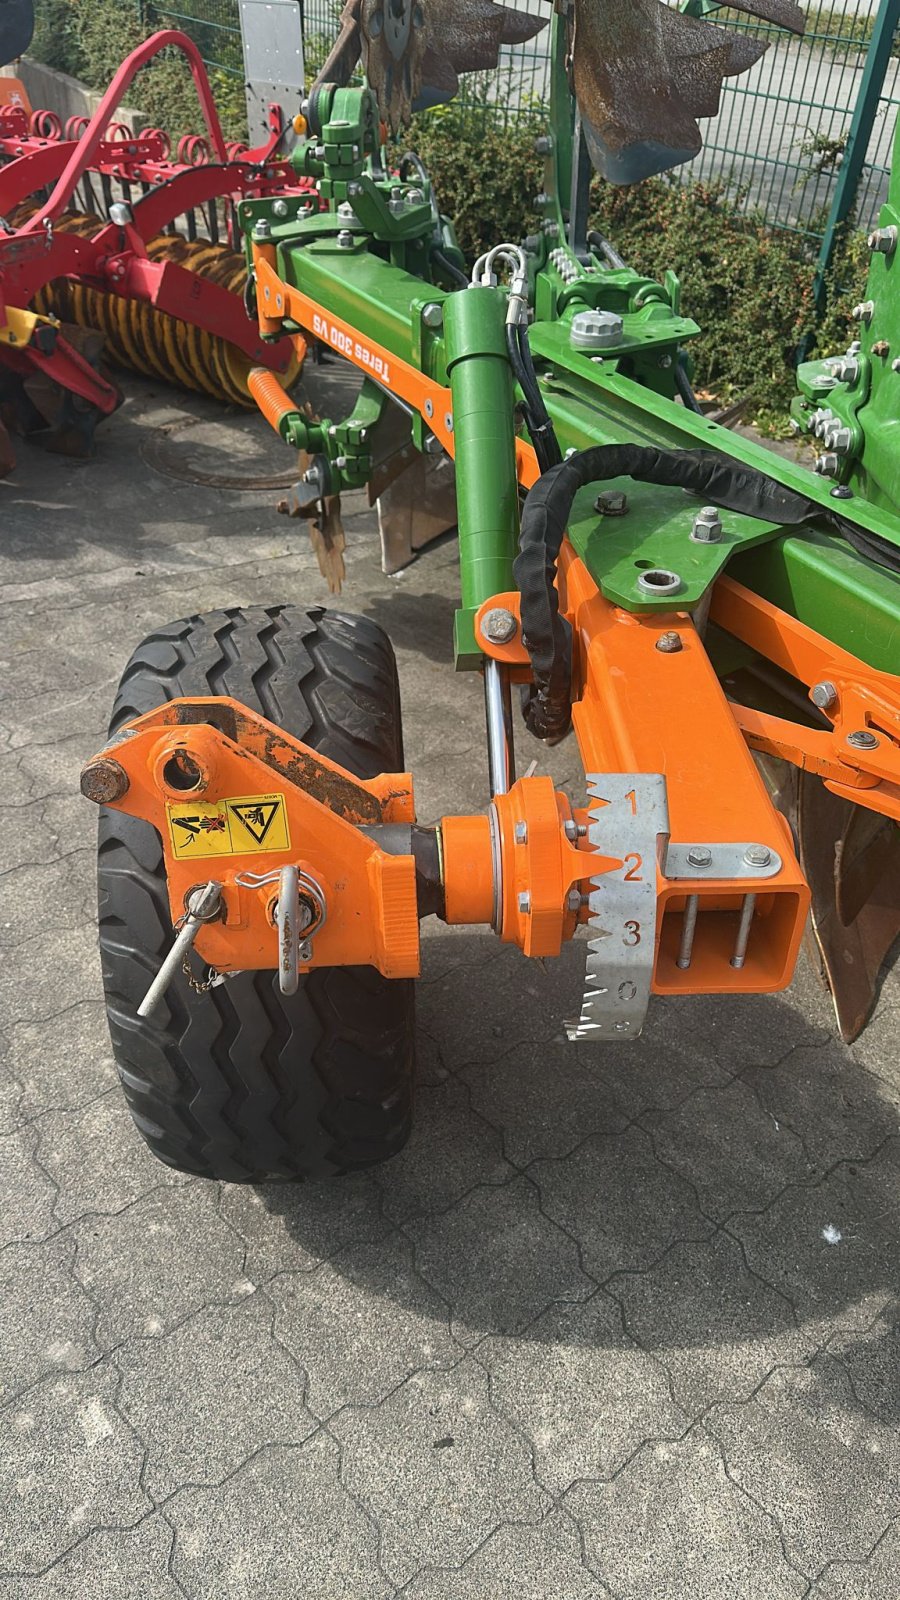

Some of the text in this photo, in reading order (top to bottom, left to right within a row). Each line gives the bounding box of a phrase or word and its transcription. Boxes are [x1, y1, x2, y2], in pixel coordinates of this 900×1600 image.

[313, 314, 390, 384] Teres 300 VS
[624, 789, 637, 816] 1
[623, 852, 643, 882] 2
[622, 920, 641, 947] 3
